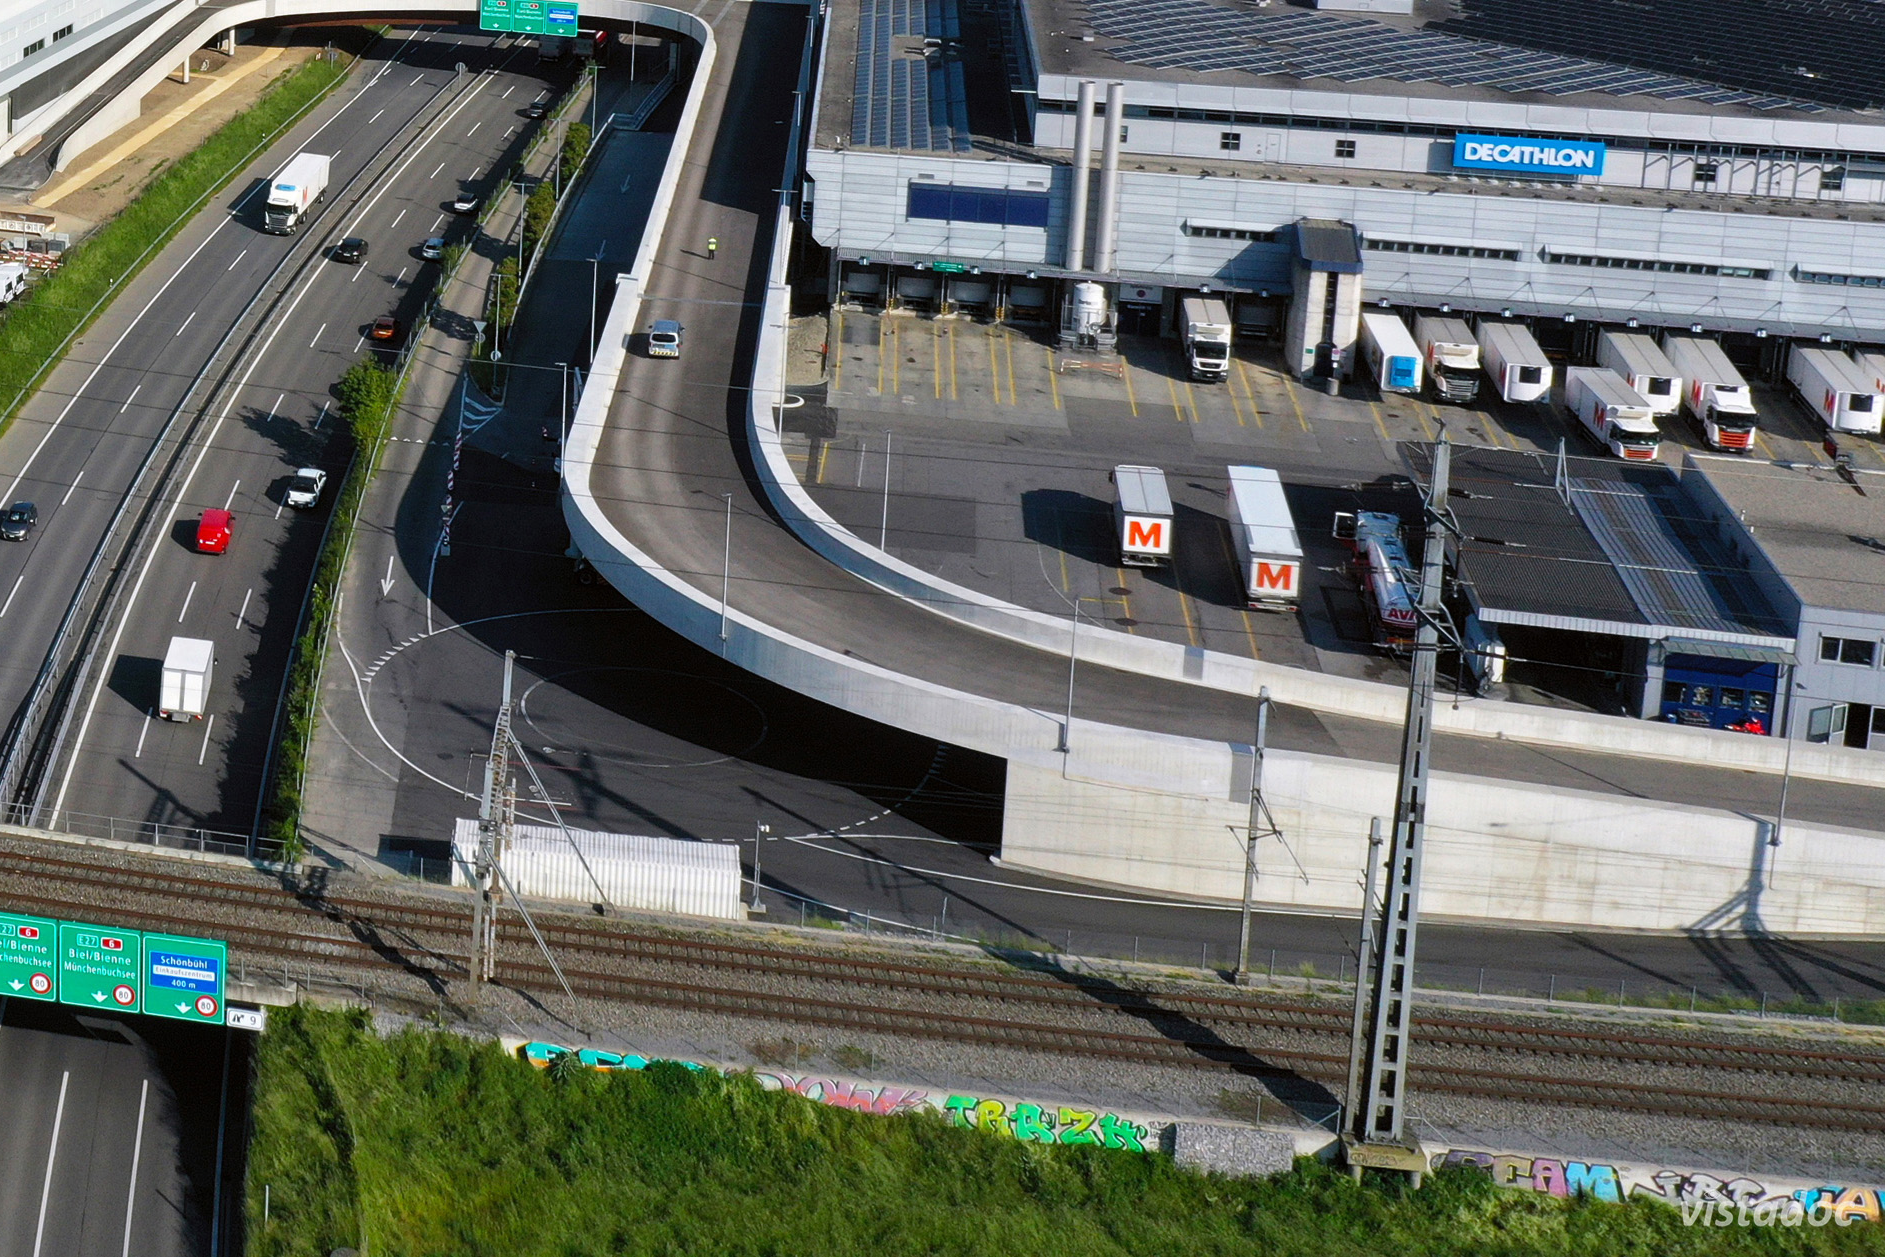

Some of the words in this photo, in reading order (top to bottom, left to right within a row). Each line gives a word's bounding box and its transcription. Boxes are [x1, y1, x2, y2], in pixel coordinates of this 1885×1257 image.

[1464, 142, 1595, 168] DECATHLON
[1128, 521, 1162, 548] M
[1256, 562, 1292, 590] M
[79, 935, 95, 945] E27
[69, 948, 131, 965] Biel/Bienne
[161, 955, 208, 969] Schönbühl
[64, 961, 135, 980] Münchenbuchsee
[155, 966, 213, 979] Einkaufszentrum
[34, 978, 45, 987] 80
[171, 979, 186, 988] 400
[118, 991, 129, 1000] 80
[201, 1001, 211, 1010] 80
[250, 1016, 256, 1025] 9
